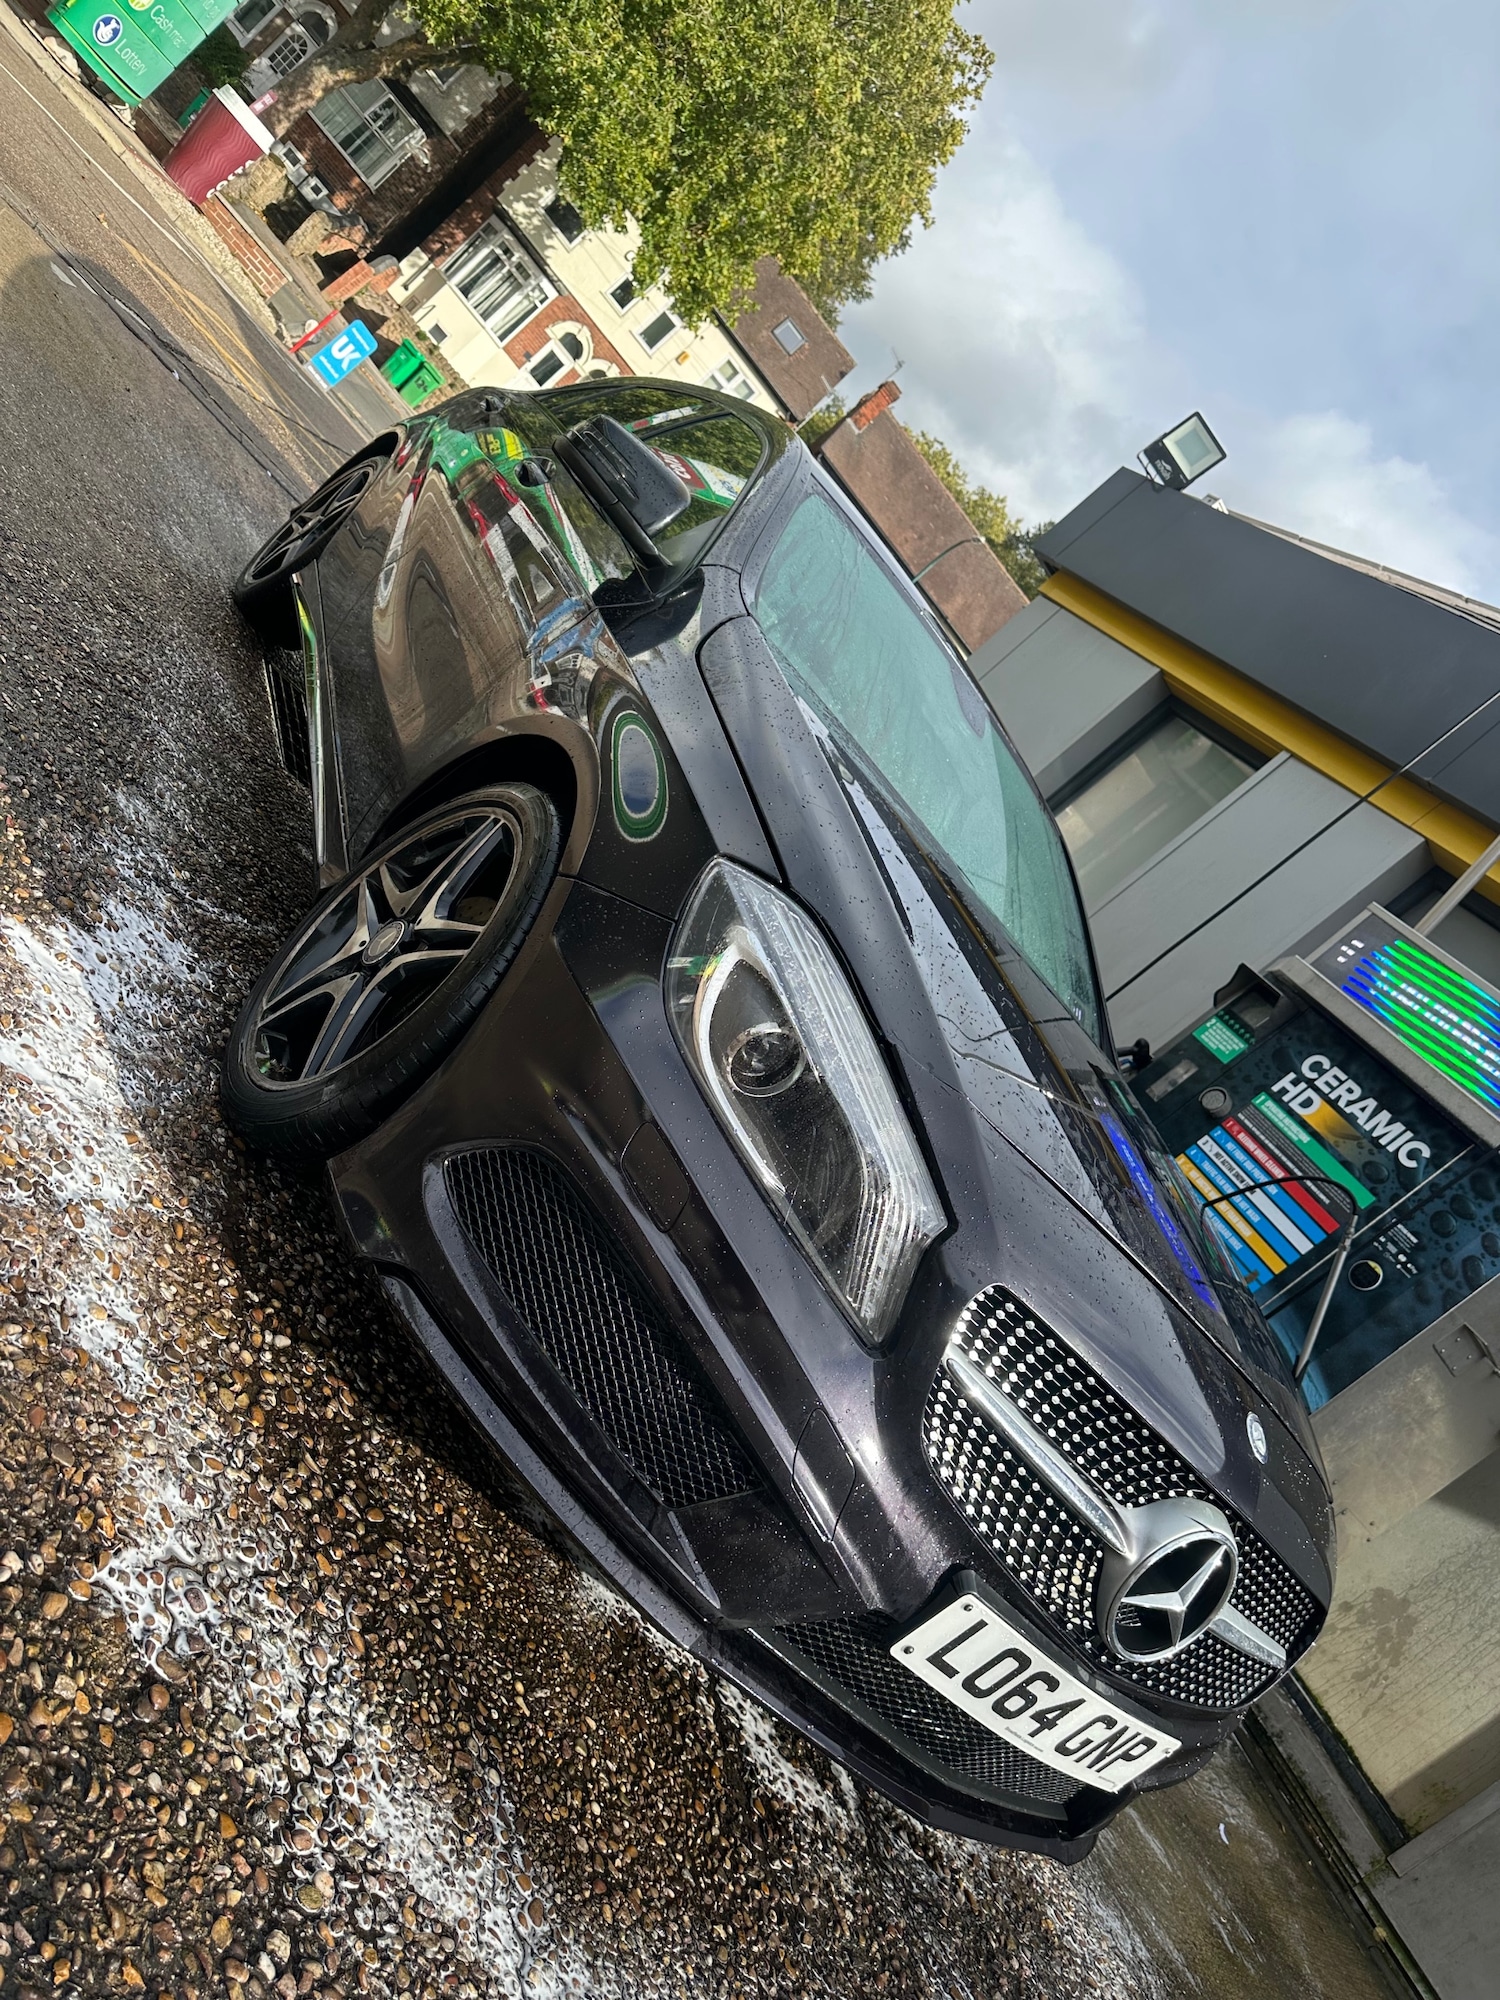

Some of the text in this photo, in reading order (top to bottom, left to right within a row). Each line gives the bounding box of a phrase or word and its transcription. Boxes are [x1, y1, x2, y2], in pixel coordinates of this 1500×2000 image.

[149, 6, 175, 33] Cash
[113, 39, 148, 75] Lottery
[1205, 1018, 1216, 1027] 2
[1255, 1095, 1265, 1104] 1
[1270, 1071, 1321, 1116] HD
[1301, 1055, 1430, 1168] CERAMIC
[1200, 1139, 1256, 1195] 3 HOT ACTIVE SNOW FM
[1224, 1141, 1236, 1151] HOT
[1231, 1148, 1247, 1163] FRONT
[1252, 1147, 1269, 1162] WHEEL
[1201, 1160, 1217, 1177] TRAFFIC
[1214, 1174, 1226, 1186] FILM
[1237, 1200, 1249, 1211] HOT
[1245, 1208, 1260, 1223] WASH
[1211, 1216, 1243, 1250] STANDARD RINSE
[1225, 1209, 1239, 1223] FOAM
[1235, 1220, 1252, 1237] BRUSH
[925, 1619, 1157, 1773] LO64 GNP
